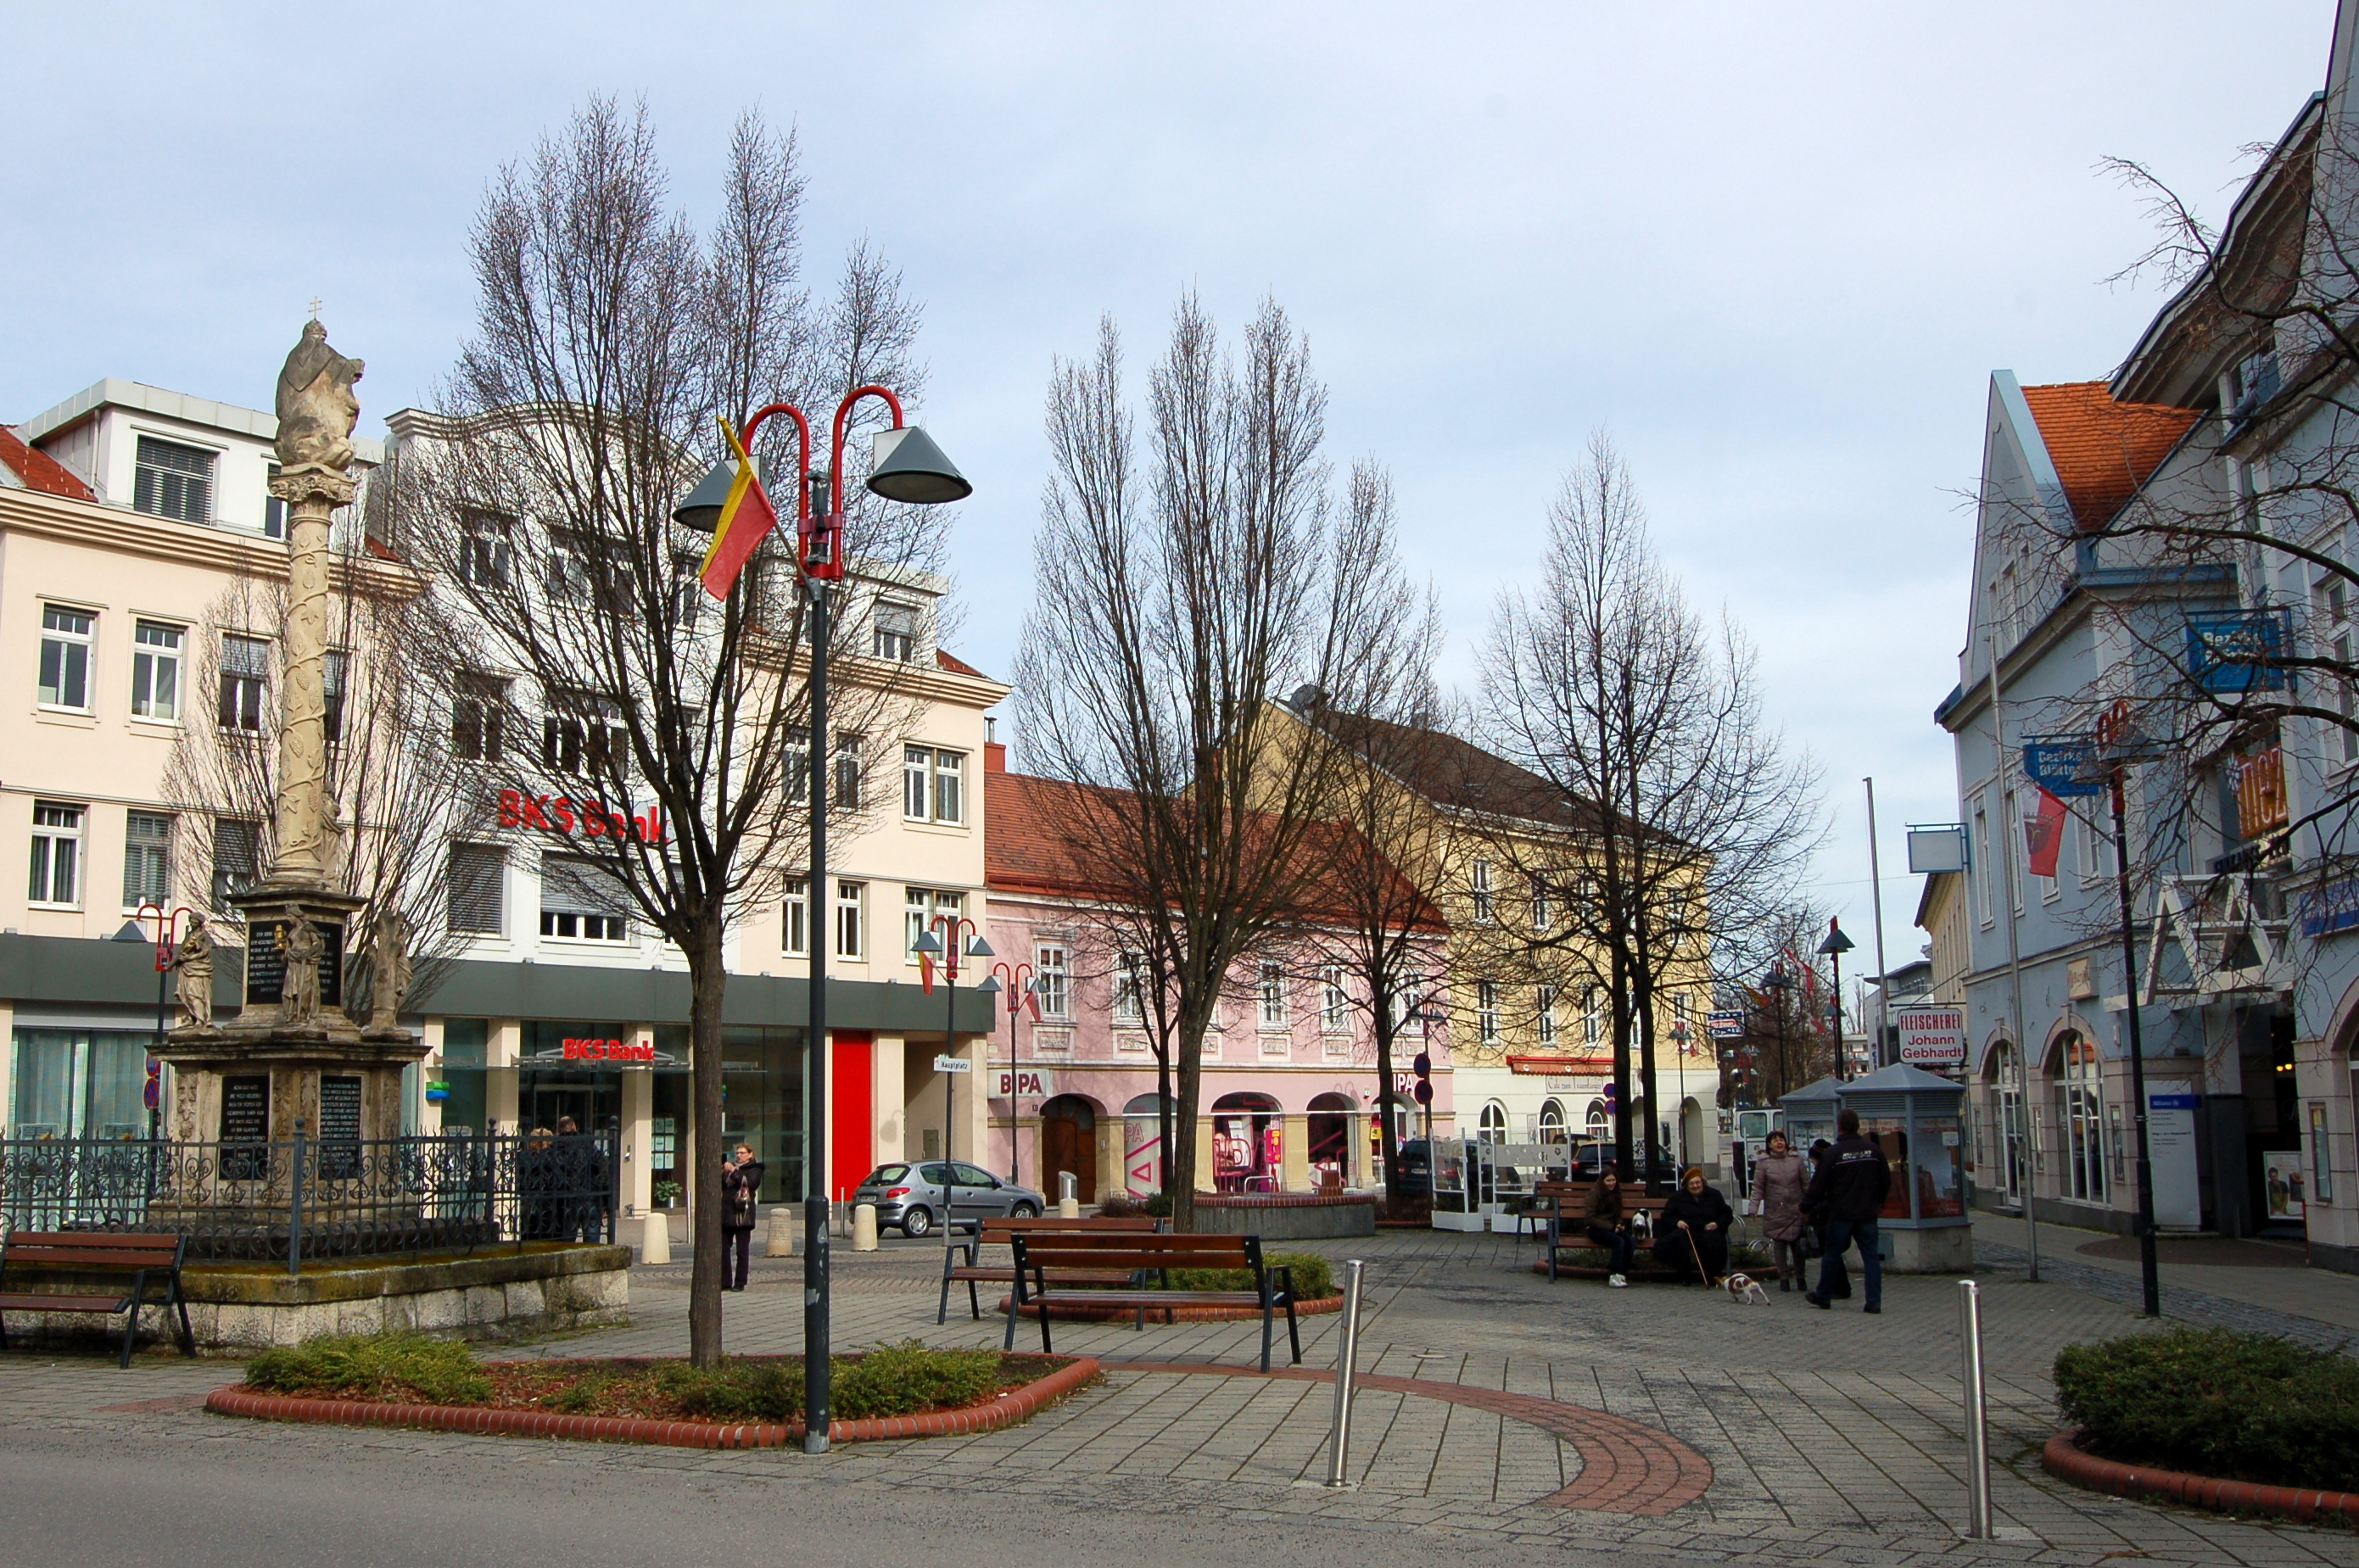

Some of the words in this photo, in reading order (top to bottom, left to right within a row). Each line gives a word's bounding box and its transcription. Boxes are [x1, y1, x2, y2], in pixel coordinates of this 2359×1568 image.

[499, 789, 574, 834] BKS
[1900, 1013, 1960, 1030] FLEISCHEREI
[562, 1039, 605, 1059] BKS
[607, 1040, 656, 1060] Bank
[1908, 1035, 1955, 1046] Johann
[1902, 1047, 1962, 1058] Gebhardt
[1000, 1074, 1043, 1094] BPA
[1393, 1073, 1414, 1092] IPA
